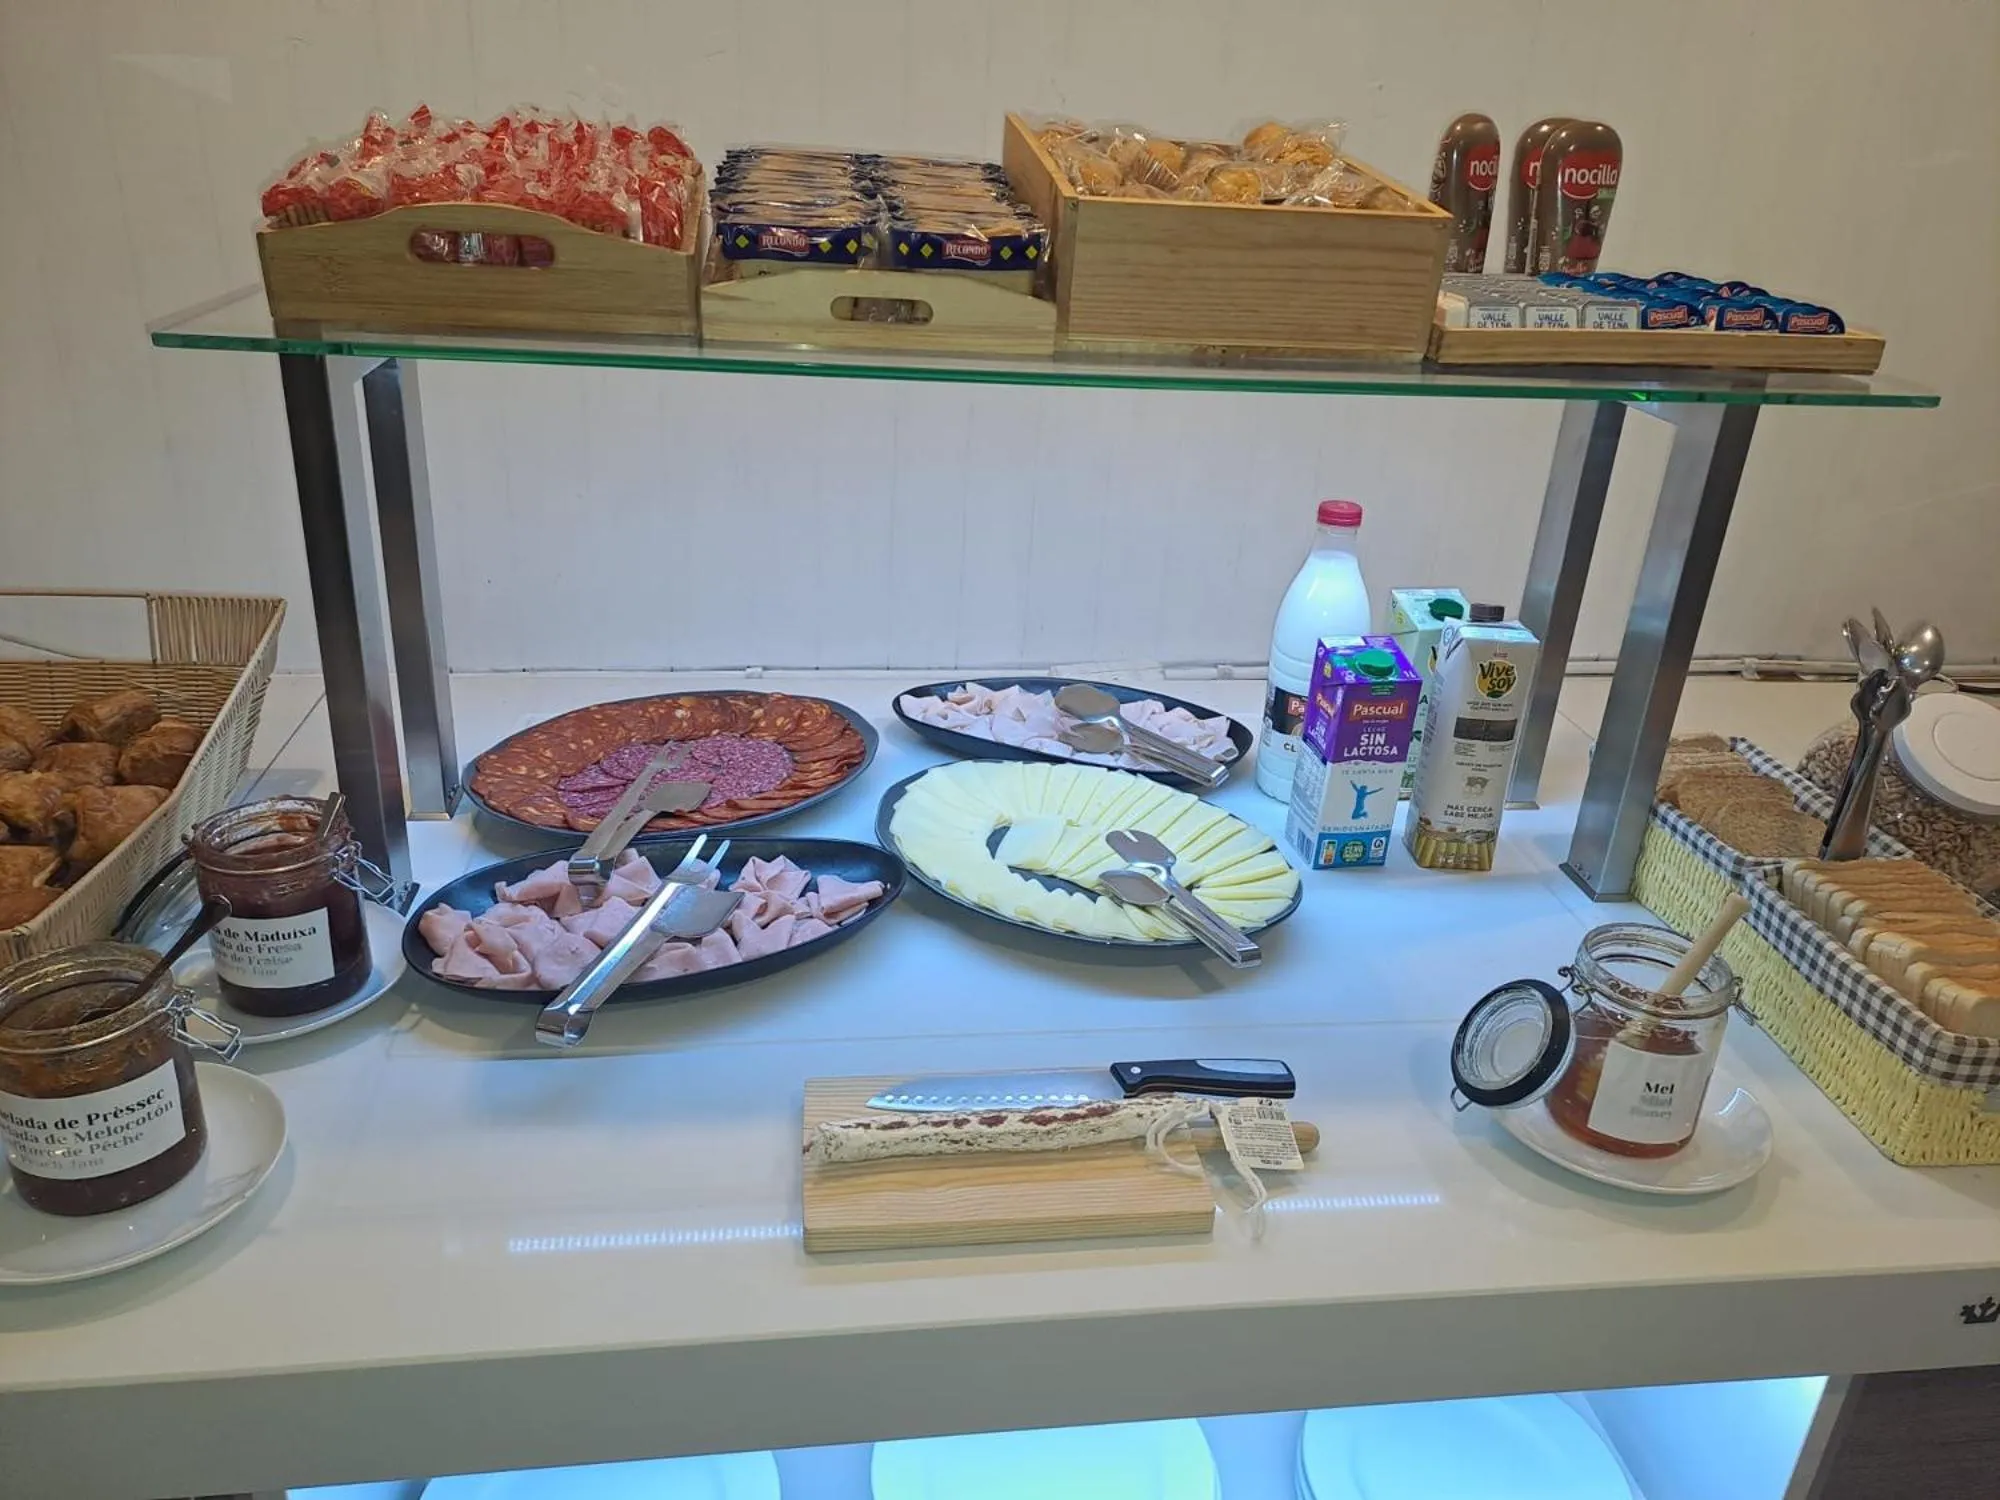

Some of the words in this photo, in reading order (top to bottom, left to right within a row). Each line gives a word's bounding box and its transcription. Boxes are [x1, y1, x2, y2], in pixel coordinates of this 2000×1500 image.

[1470, 155, 1498, 176] noci
[1564, 165, 1618, 185] nocilla
[1650, 310, 1685, 321] Pascual
[1725, 311, 1762, 322] Pascual
[1790, 315, 1827, 326] Pascual
[1353, 703, 1404, 716] Pascual
[1360, 733, 1386, 746] SIN
[1343, 746, 1398, 757] LACTOSA
[223, 927, 239, 939] de
[244, 926, 317, 942] Maduixa
[1643, 1081, 1675, 1095] Mel
[54, 1118, 79, 1130] de
